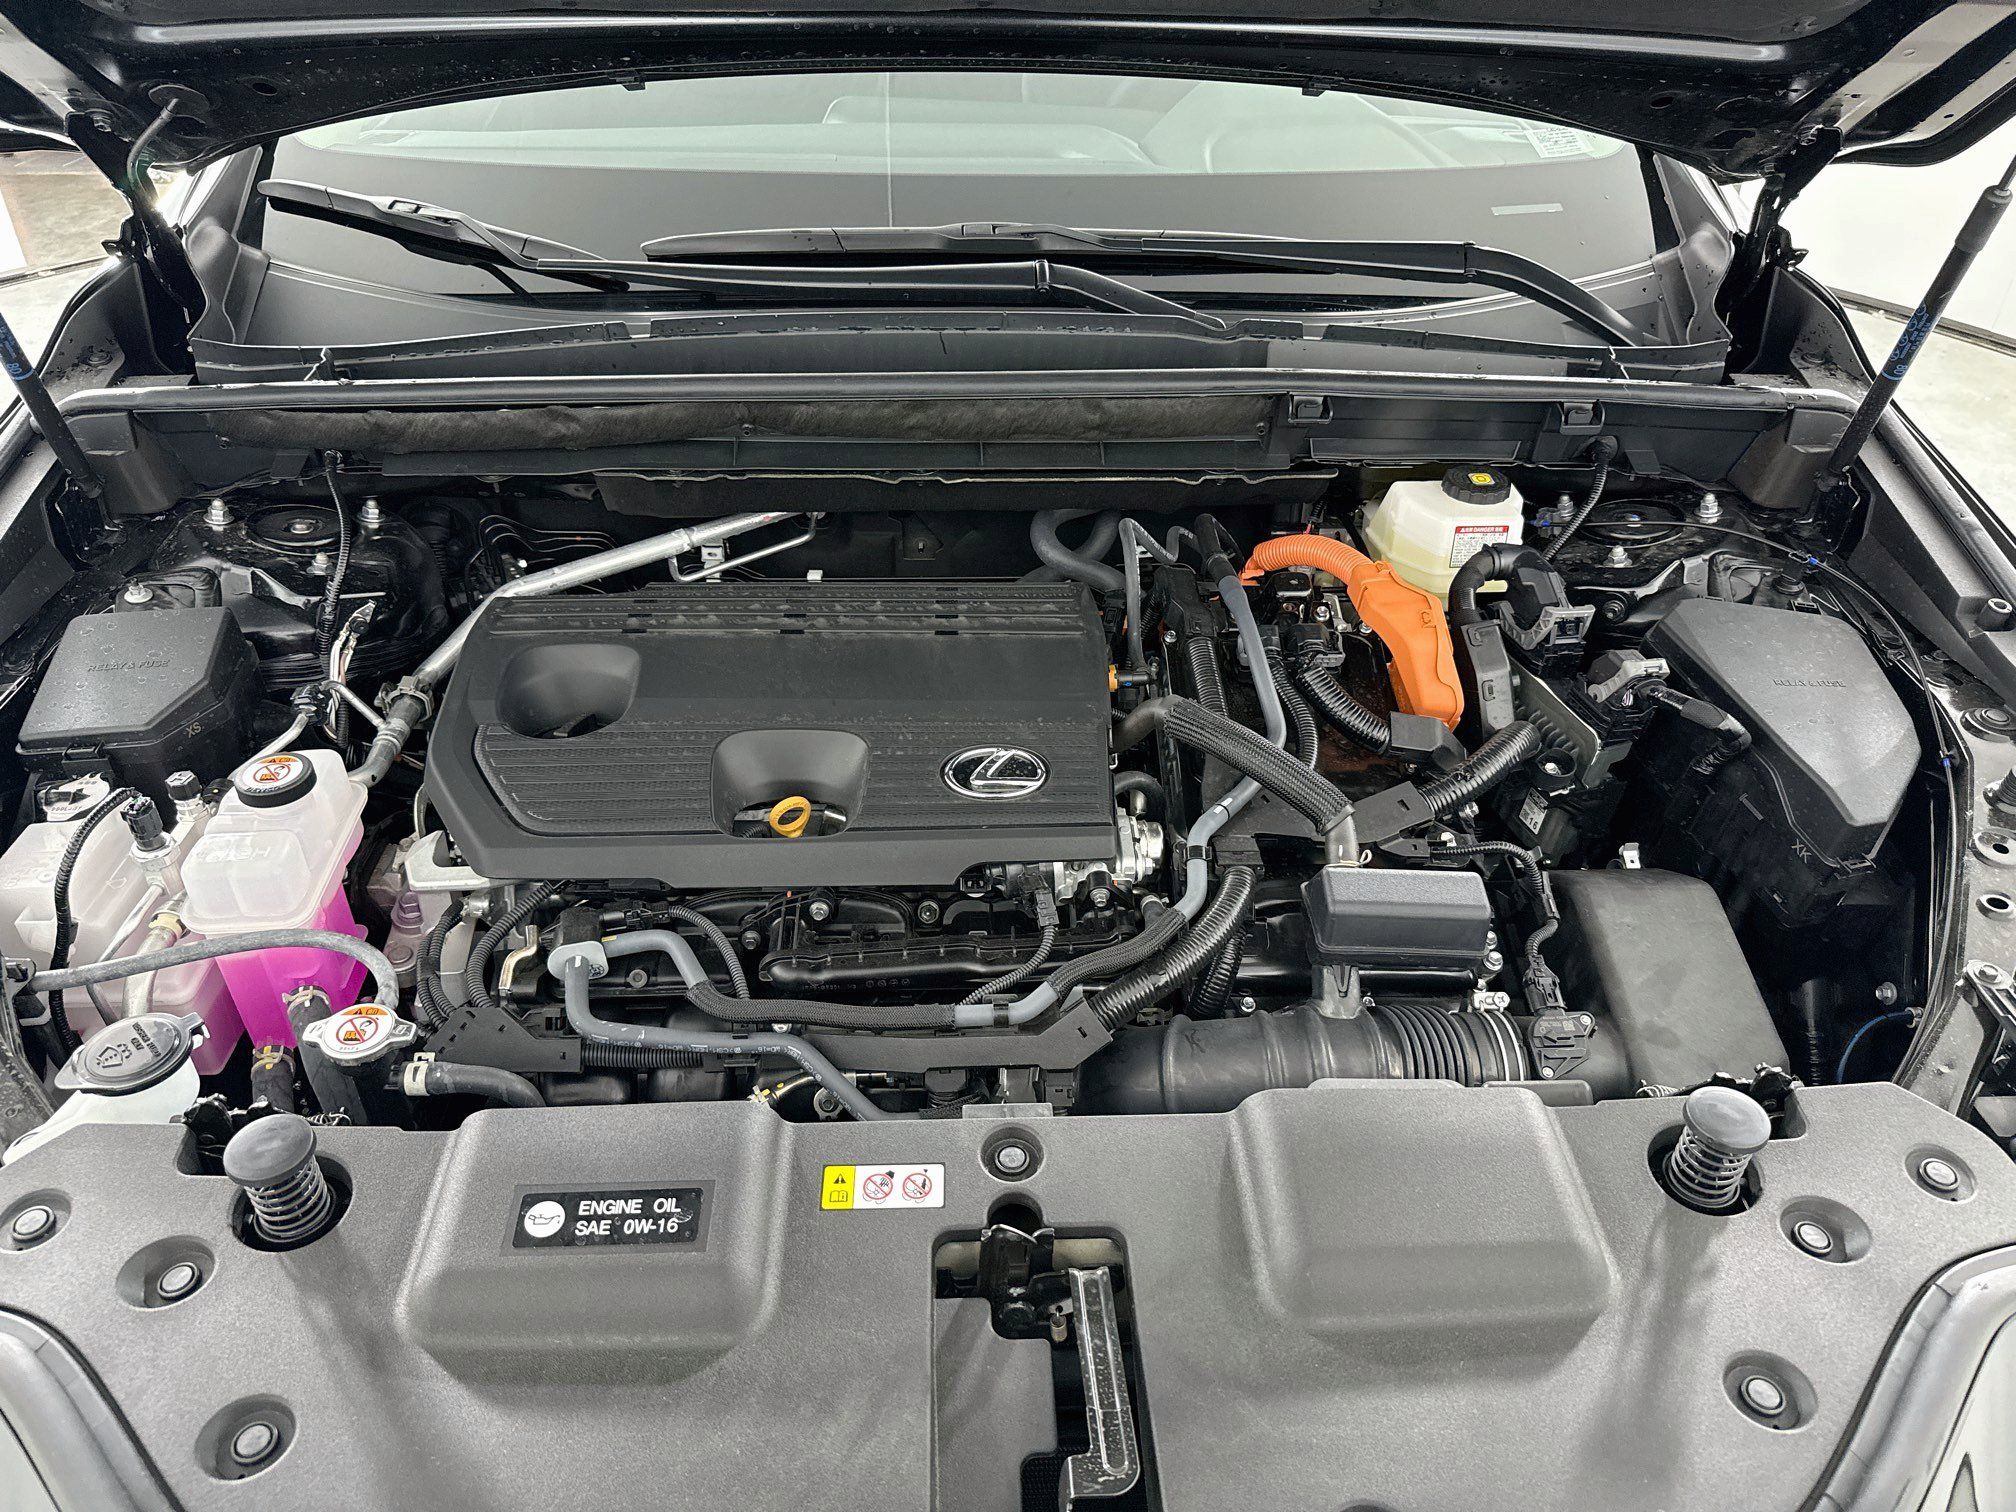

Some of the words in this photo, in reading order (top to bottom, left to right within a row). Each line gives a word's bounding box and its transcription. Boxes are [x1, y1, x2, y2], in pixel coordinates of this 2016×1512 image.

[139, 660, 171, 669] FUSE
[186, 721, 201, 739] XS
[578, 1199, 643, 1216] ENGINE
[653, 1198, 682, 1213] OIL
[575, 1219, 613, 1236] SAE
[623, 1218, 679, 1235] 0W-16
